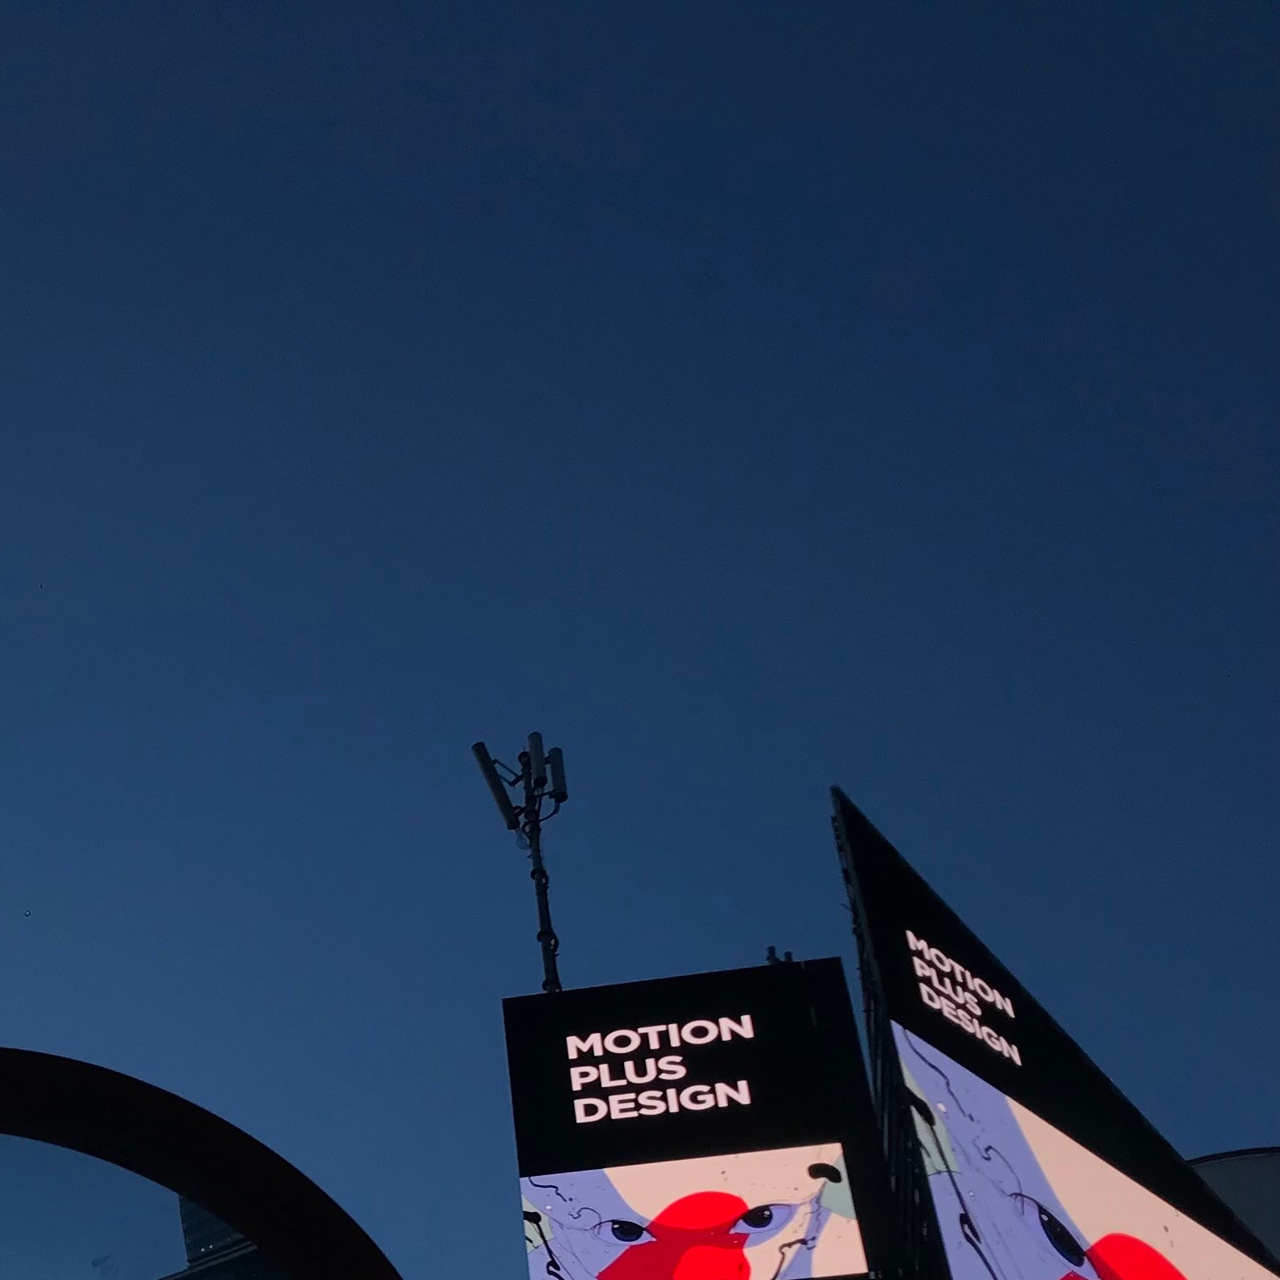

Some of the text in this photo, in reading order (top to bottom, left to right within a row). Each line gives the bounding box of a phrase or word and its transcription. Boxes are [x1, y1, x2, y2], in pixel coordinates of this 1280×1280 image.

[905, 929, 1016, 1019] MOTION
[912, 955, 982, 1016] PLUS
[566, 1014, 755, 1060] MOTION
[919, 982, 1023, 1067] DESIGN
[569, 1055, 687, 1091] PLUS
[573, 1080, 752, 1124] DESIGN
